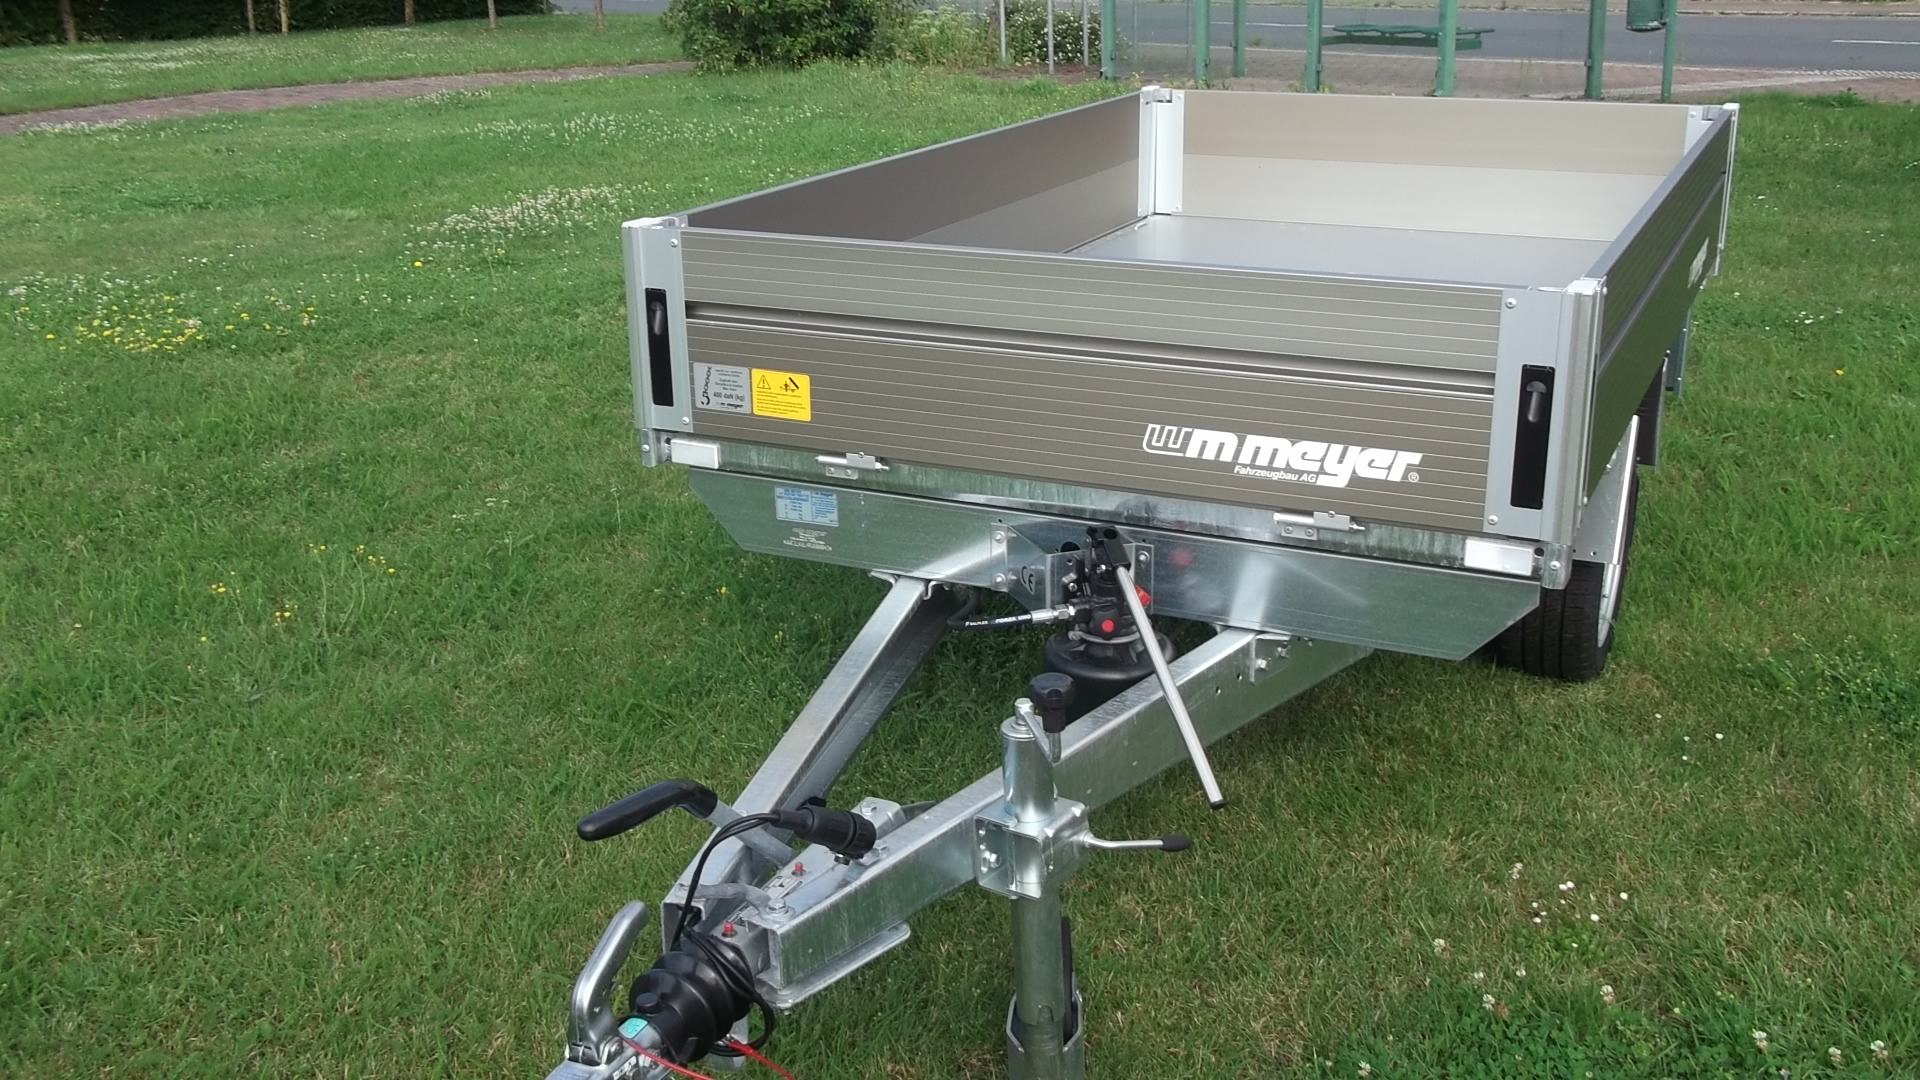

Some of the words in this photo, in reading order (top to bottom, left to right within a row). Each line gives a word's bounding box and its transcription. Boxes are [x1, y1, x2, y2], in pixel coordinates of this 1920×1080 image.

[1234, 466, 1298, 481] Fahrzeugbau
[1300, 473, 1317, 483] AG
[1238, 435, 1423, 488] meyer
